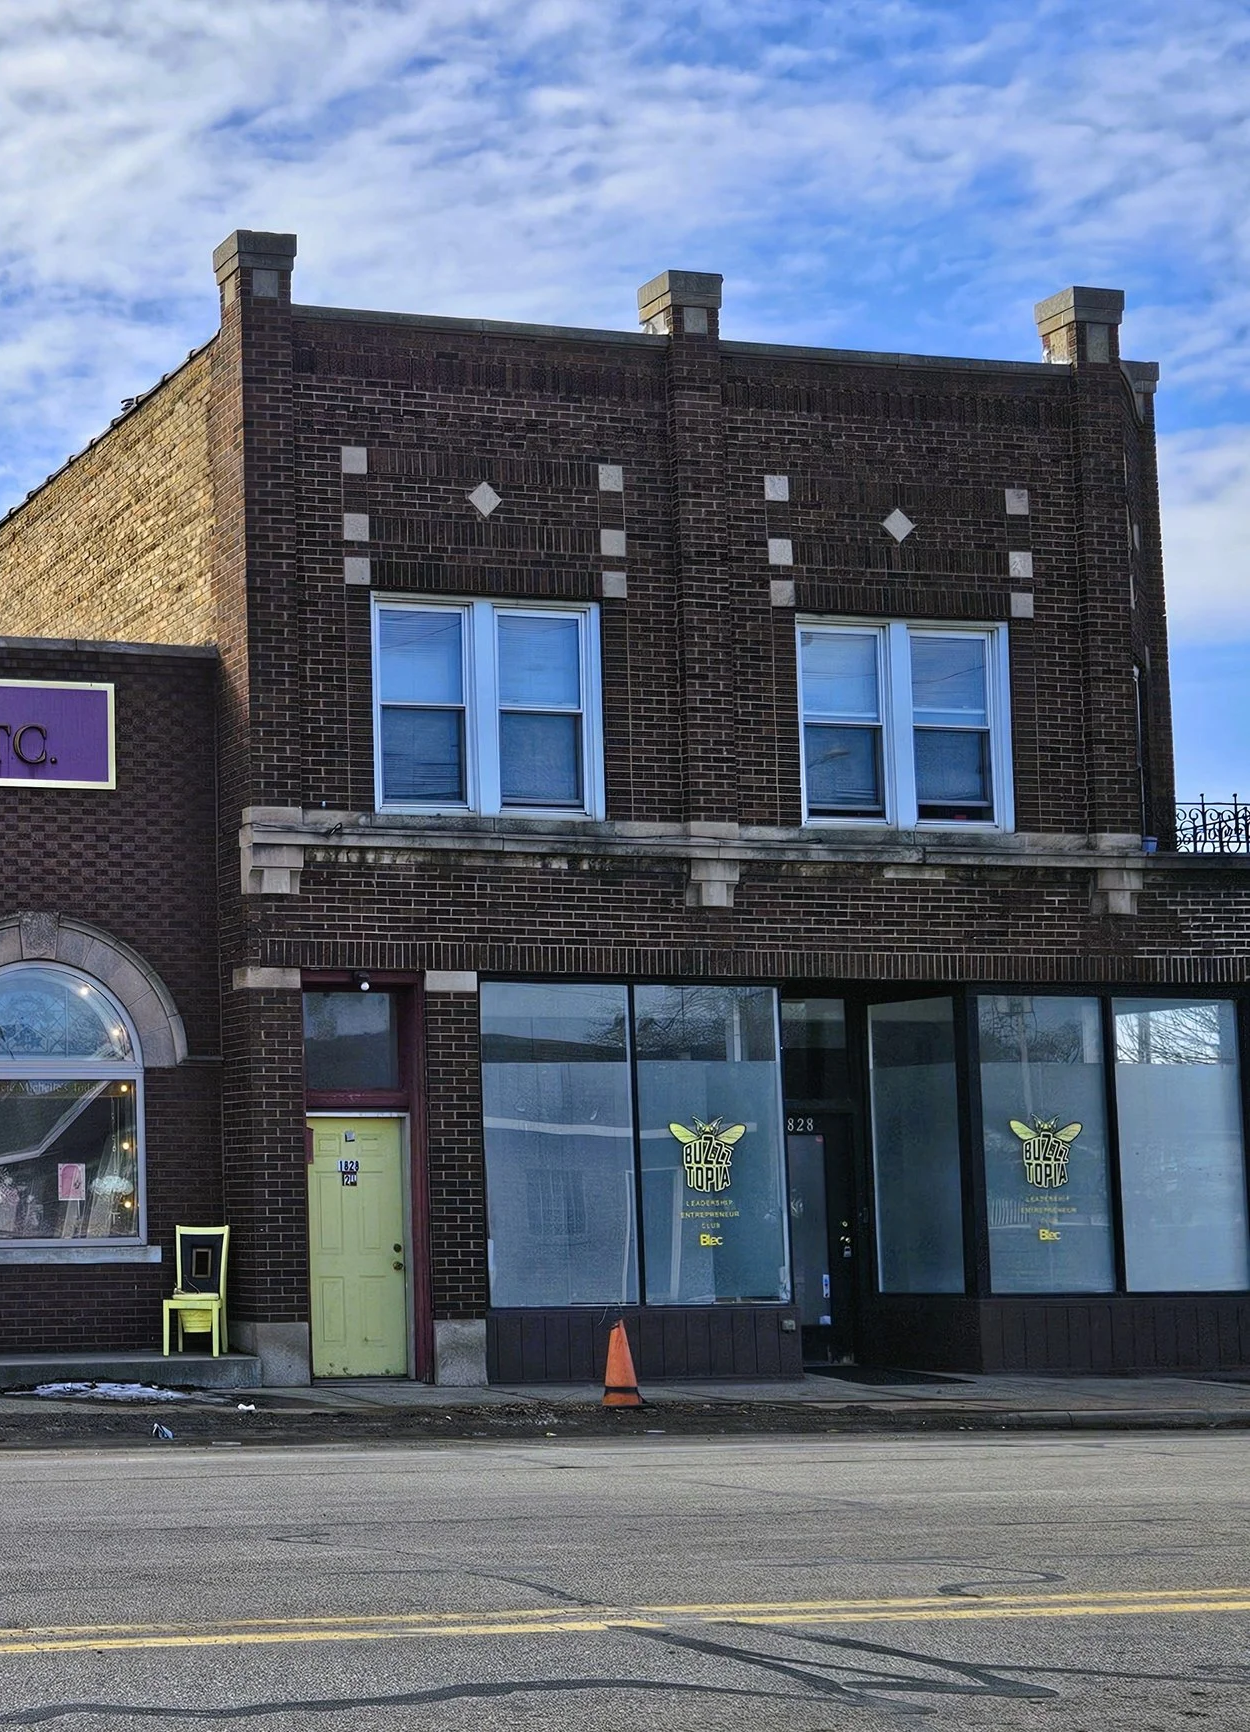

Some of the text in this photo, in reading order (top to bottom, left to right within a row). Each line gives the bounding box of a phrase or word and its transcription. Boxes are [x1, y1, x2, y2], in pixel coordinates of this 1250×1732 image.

[339, 1160, 360, 1172] 1828
[685, 1164, 732, 1192] TOPIA
[1024, 1161, 1069, 1189] TOPIA
[685, 1199, 734, 1207] LEADERSHIP
[680, 1211, 740, 1219] ENTREPRENEUR
